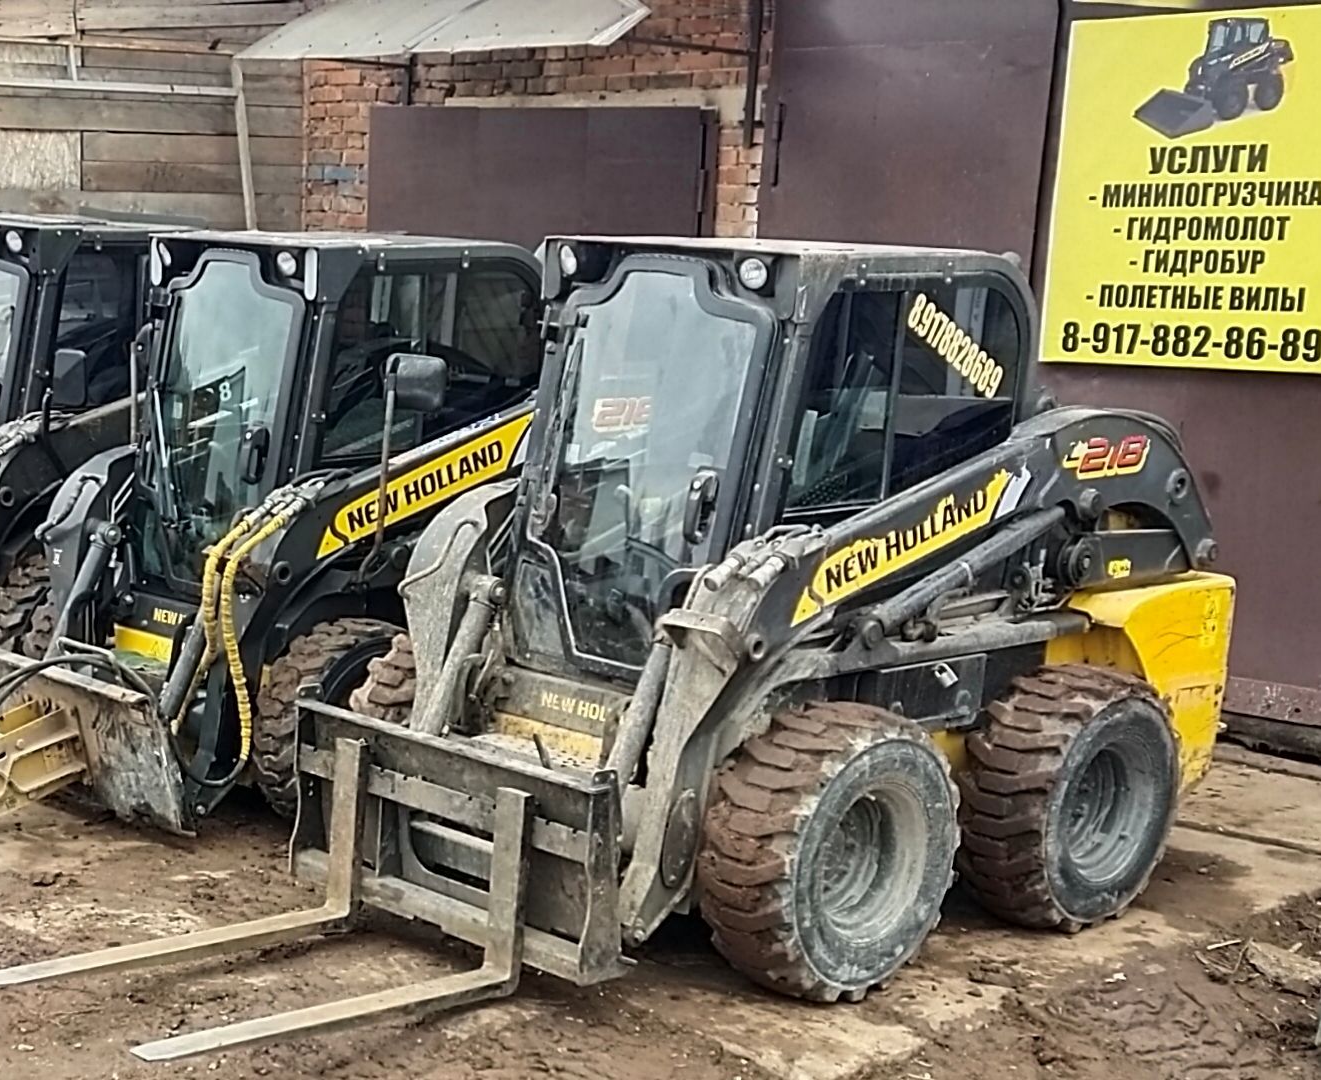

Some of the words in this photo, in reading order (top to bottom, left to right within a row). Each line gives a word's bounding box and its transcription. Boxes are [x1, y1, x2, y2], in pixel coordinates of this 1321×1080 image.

[1148, 143, 1269, 175] УСЛУГИ
[1102, 180, 1321, 209] МИНИПОГРУЗЧИКА
[1126, 215, 1291, 244] ГИДРОМОЛОТ
[1142, 249, 1266, 277] ГИДРОБУР
[1099, 284, 1224, 310] ПОЛЕТНЫЕ
[1228, 286, 1306, 313] ВИЛЫ
[1061, 322, 1321, 363] 8-917-882-86-89
[346, 488, 399, 533] NEW
[403, 440, 504, 506] HOLLAND
[825, 545, 879, 594] NEW
[886, 490, 987, 562] HOLLAND
[153, 607, 178, 625] NEW
[541, 690, 576, 714] NEW
